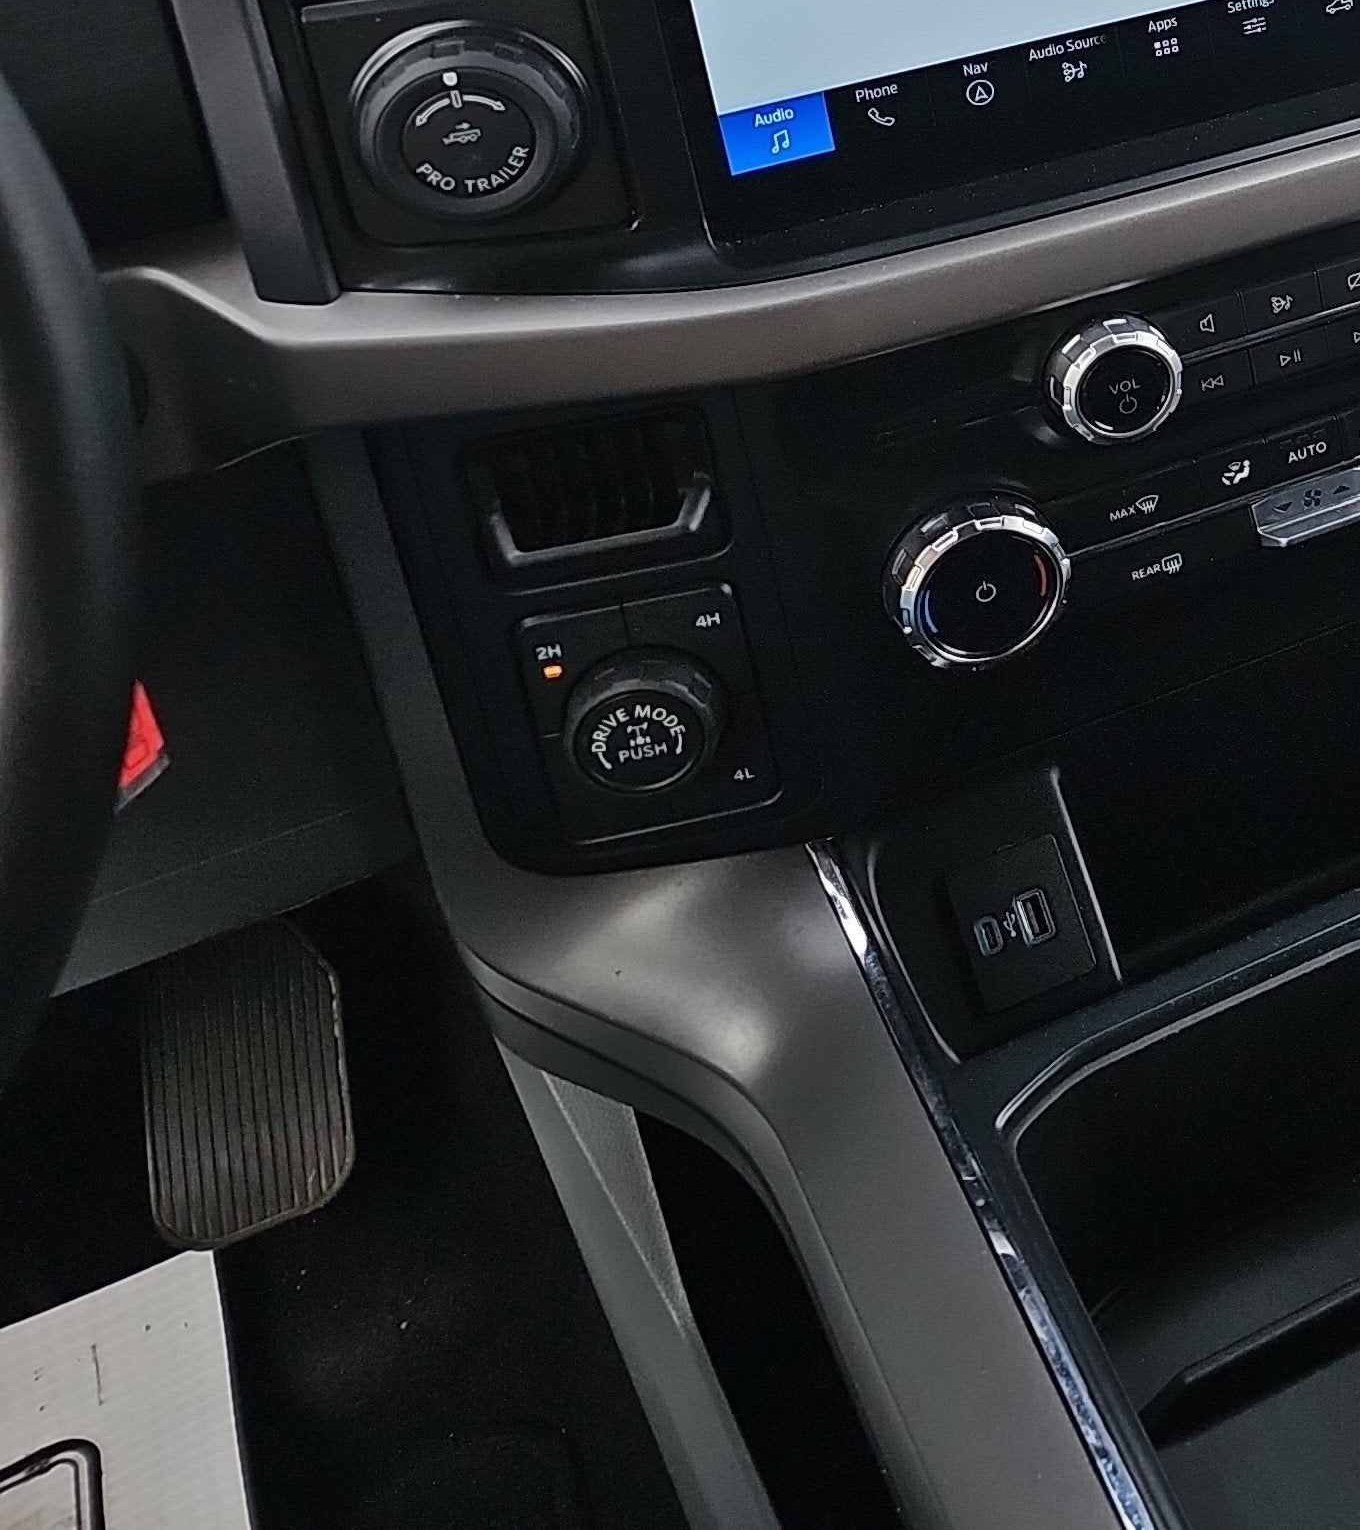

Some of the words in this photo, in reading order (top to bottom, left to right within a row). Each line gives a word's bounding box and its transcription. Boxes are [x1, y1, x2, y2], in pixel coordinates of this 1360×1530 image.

[1148, 15, 1178, 34] Apps
[1028, 43, 1065, 62] Audio
[963, 61, 989, 76] Nav
[855, 83, 899, 103] Phone
[754, 107, 795, 128] Audio
[416, 163, 455, 191] PRO
[464, 146, 529, 193] TRAILER
[1109, 377, 1141, 395] VOL
[1287, 441, 1327, 464] AUTO
[1109, 504, 1136, 521] MAX
[1131, 562, 1161, 580] REAR
[695, 612, 721, 628] 4H
[536, 644, 562, 661] 2H
[591, 707, 629, 753] DRIVE
[634, 704, 686, 737] MODE
[617, 741, 668, 763] PUSH
[733, 767, 756, 781] 4L
